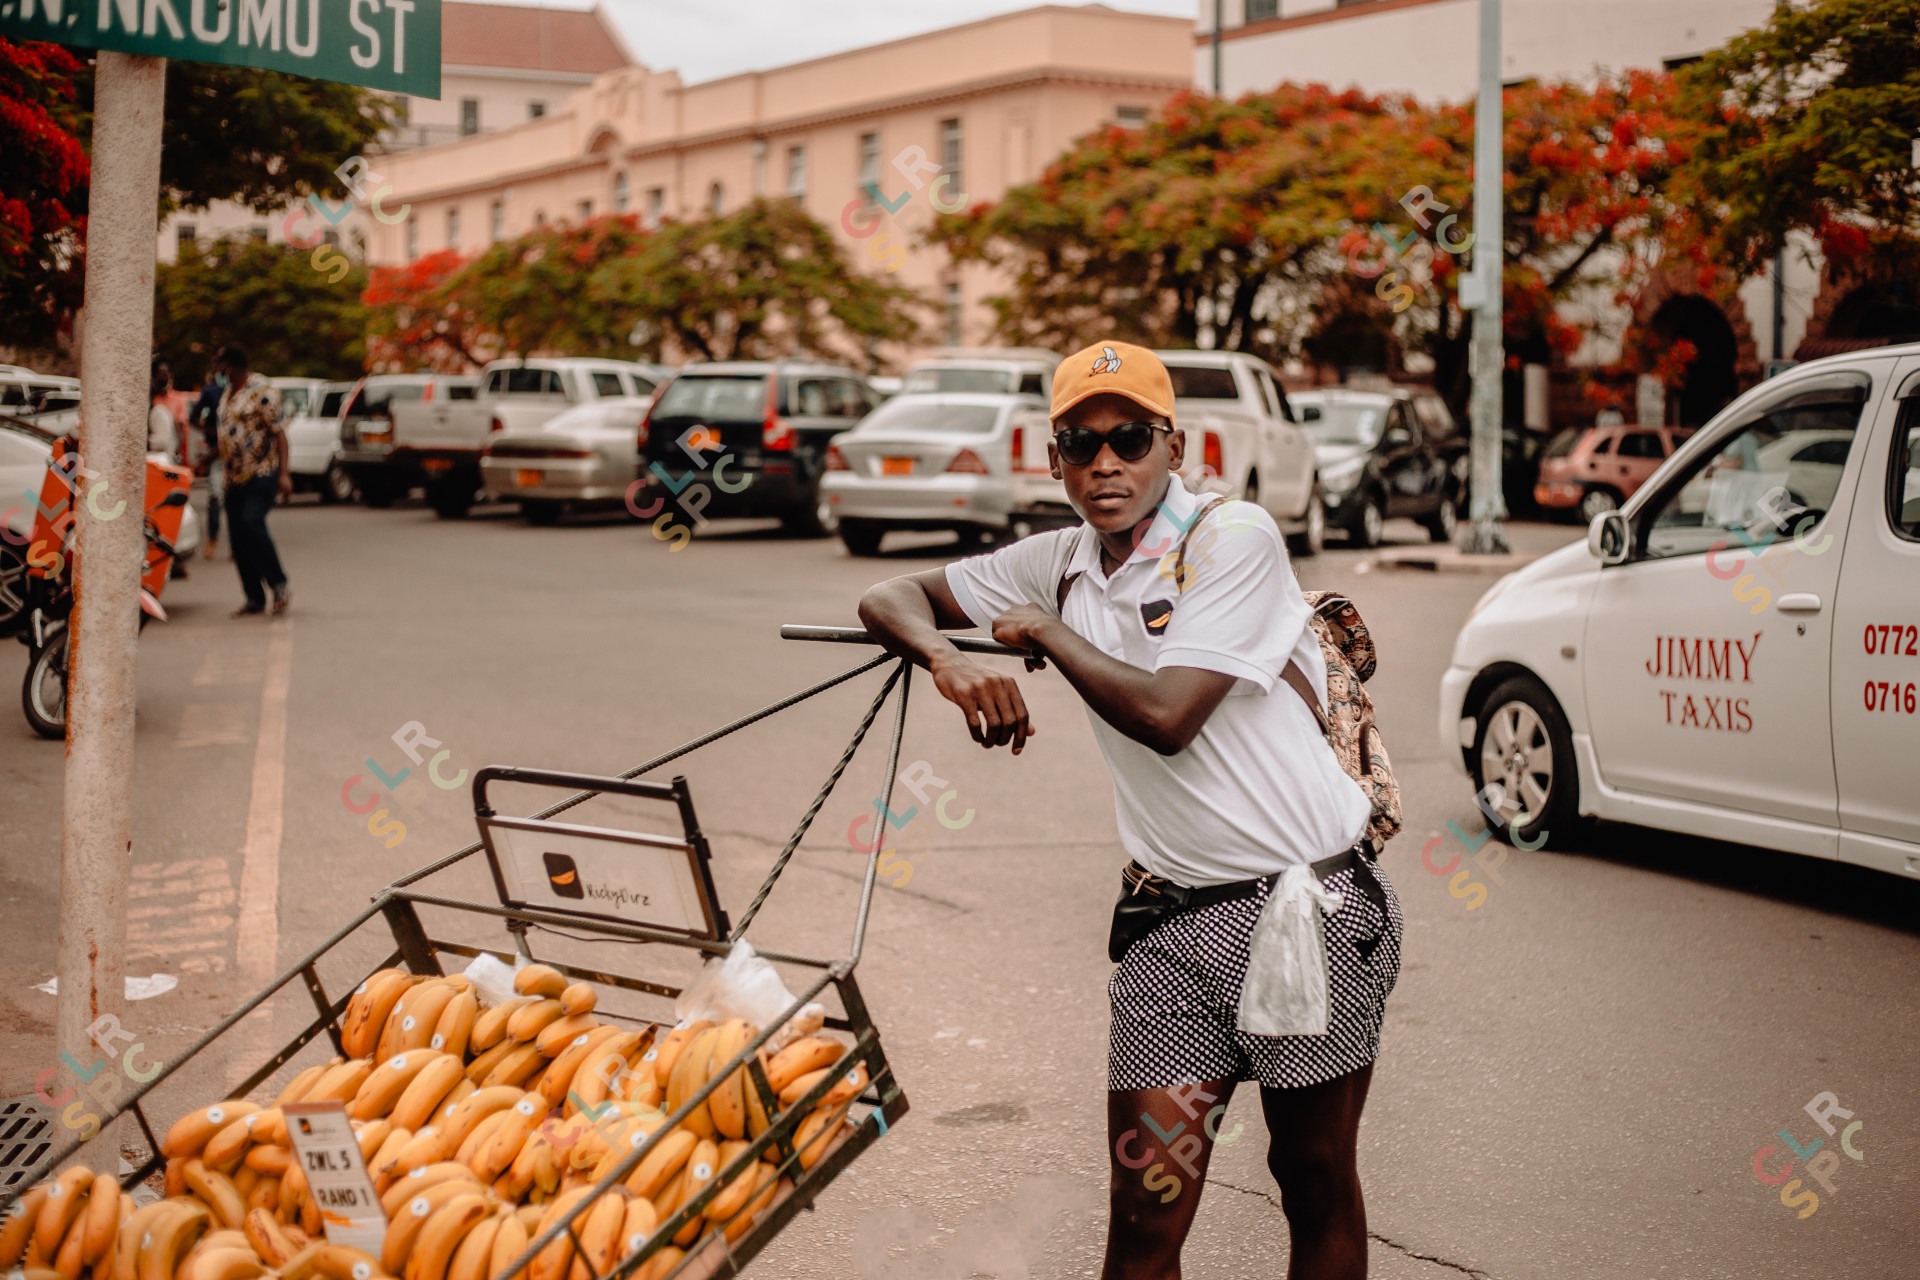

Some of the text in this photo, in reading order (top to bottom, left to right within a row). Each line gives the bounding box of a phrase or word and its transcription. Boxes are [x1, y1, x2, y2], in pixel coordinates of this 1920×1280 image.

[349, 0, 415, 74] ST
[1646, 629, 1763, 683] JIMMY
[1864, 624, 1918, 656] 0772
[1659, 689, 1753, 733] TAXIS
[1864, 680, 1917, 714] 0716
[341, 1150, 351, 1170] 5
[317, 1188, 358, 1207] RAND
